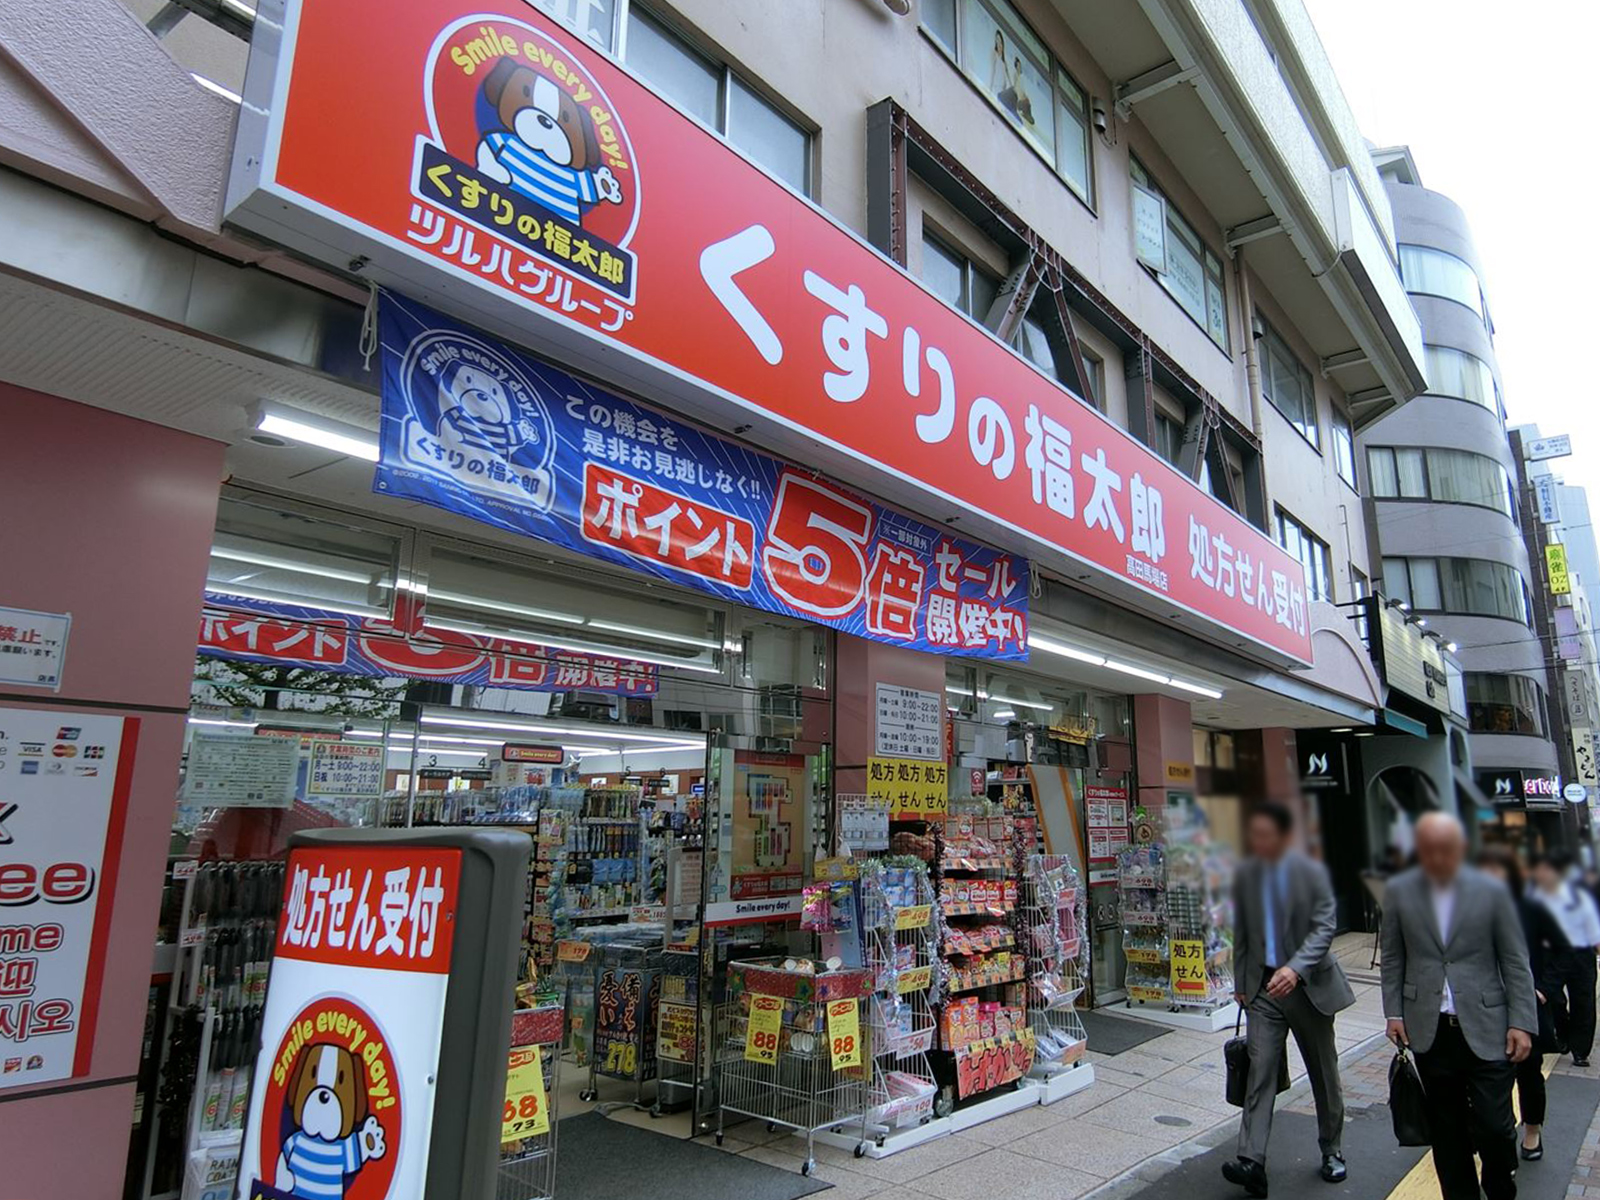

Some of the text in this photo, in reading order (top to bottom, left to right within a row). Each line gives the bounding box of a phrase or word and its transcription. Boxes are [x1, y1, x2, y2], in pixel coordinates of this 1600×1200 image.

[450, 26, 629, 171] Smile every day!
[426, 164, 626, 285] くすりの福太郎
[407, 203, 634, 332] ツルハグループ
[461, 347, 509, 384] every
[508, 379, 541, 419] day!
[564, 394, 679, 451] この機会を
[699, 223, 1305, 637] くすりの福太郎 処方せん受付
[592, 480, 749, 577] ポイント
[935, 542, 1017, 600] セール
[926, 592, 1026, 651] 開催中!
[428, 754, 437, 767] 3
[478, 757, 487, 769] 4
[871, 762, 894, 783] 処方
[898, 763, 921, 783] 処方
[924, 766, 946, 784] 処方
[898, 791, 921, 808] せん
[925, 792, 947, 809] せん
[283, 863, 444, 959] 処方せん受付
[736, 903, 756, 914] Smile
[757, 901, 775, 912] every
[1173, 944, 1202, 959] 処方
[1175, 965, 1203, 979] せん
[753, 1031, 777, 1051] 88
[833, 1035, 855, 1055] 88
[273, 1011, 396, 1110] Smile every day!
[513, 1119, 536, 1132] 73
